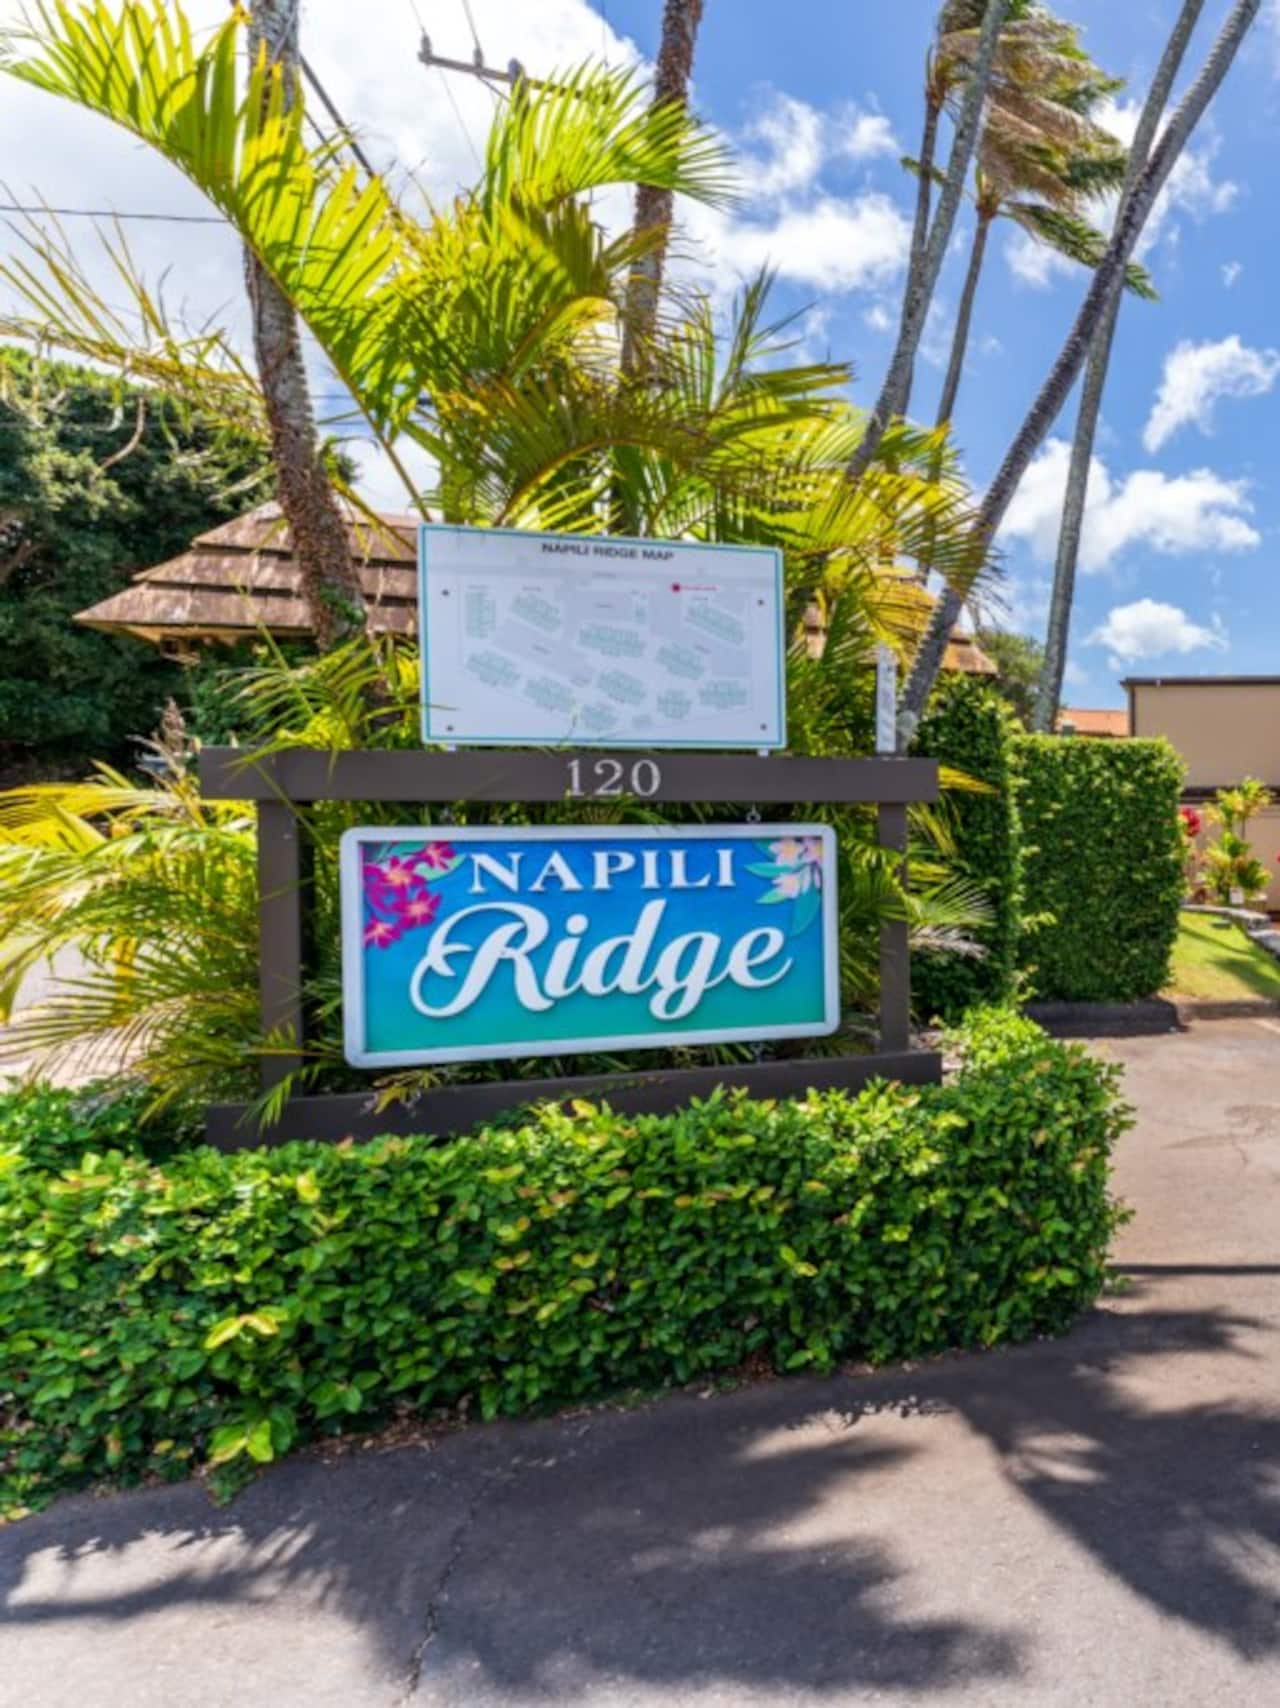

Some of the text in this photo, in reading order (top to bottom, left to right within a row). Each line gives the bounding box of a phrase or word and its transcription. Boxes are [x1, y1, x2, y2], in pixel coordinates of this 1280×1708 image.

[541, 543, 674, 560] NAPILI RIDGE MAP
[567, 758, 661, 796] 120
[469, 848, 736, 893] NAPILI
[410, 898, 793, 1021] Ridge
